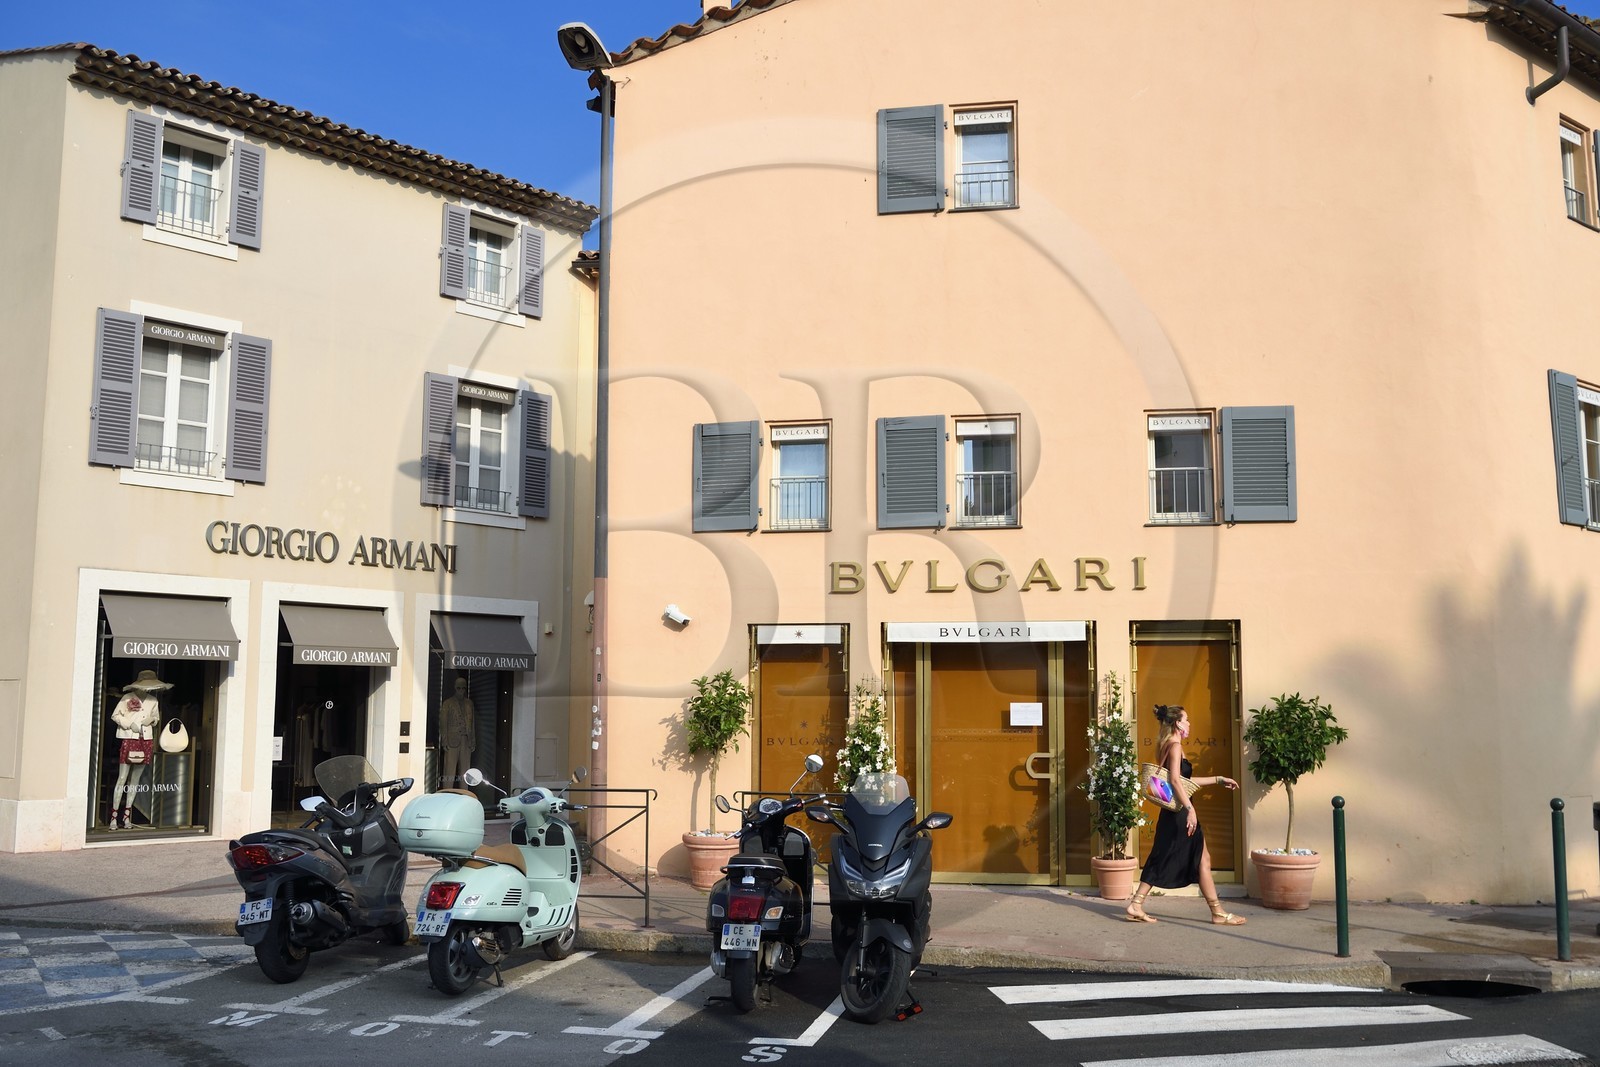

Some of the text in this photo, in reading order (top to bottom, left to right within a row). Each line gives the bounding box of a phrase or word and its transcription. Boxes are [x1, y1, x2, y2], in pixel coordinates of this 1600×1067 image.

[957, 112, 1010, 121] BVLGARI
[151, 325, 216, 345] GIORGIO ARMANI
[461, 385, 509, 400] GIORGIO ARMANI
[1152, 418, 1207, 426] BVLGARI
[775, 428, 825, 436] BVLGARI
[205, 519, 458, 574] GIORGIO ARMANI
[828, 555, 1148, 595] BVLGARI
[938, 626, 1033, 638] BVLGARI
[123, 641, 230, 658] GIORGIO ARMANI
[301, 649, 392, 664] GIORGIO ARMANI
[452, 655, 529, 669] GIORGIO ARMANI
[251, 901, 262, 911] FC
[426, 912, 437, 921] FK
[733, 926, 744, 935] CE
